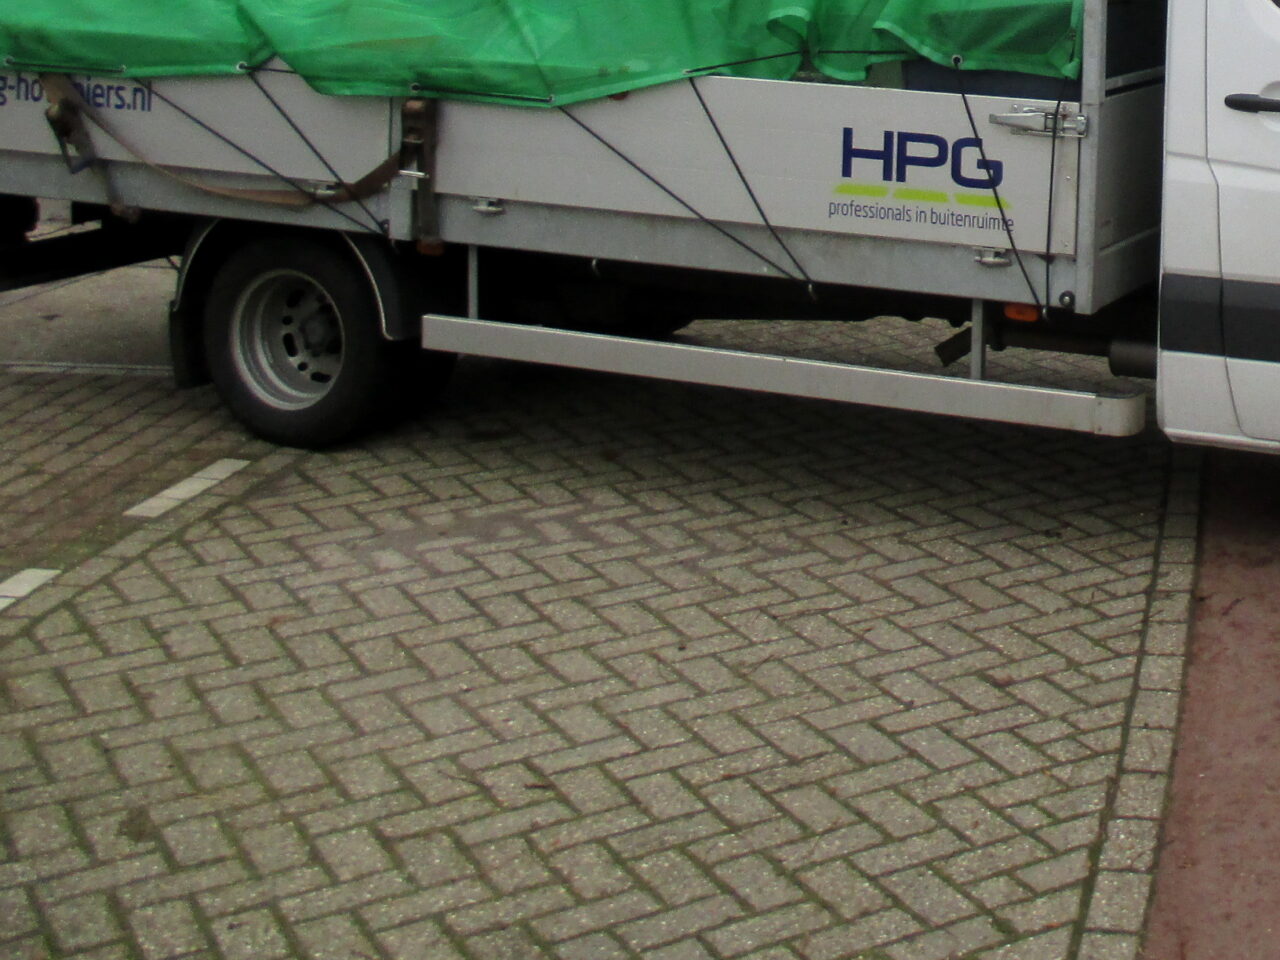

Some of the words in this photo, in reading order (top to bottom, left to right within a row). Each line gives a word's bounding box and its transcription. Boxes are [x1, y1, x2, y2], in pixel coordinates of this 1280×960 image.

[841, 126, 1004, 190] HPG
[828, 199, 912, 223] professionals
[915, 206, 927, 224] in
[930, 207, 1015, 232] buitenruimte
